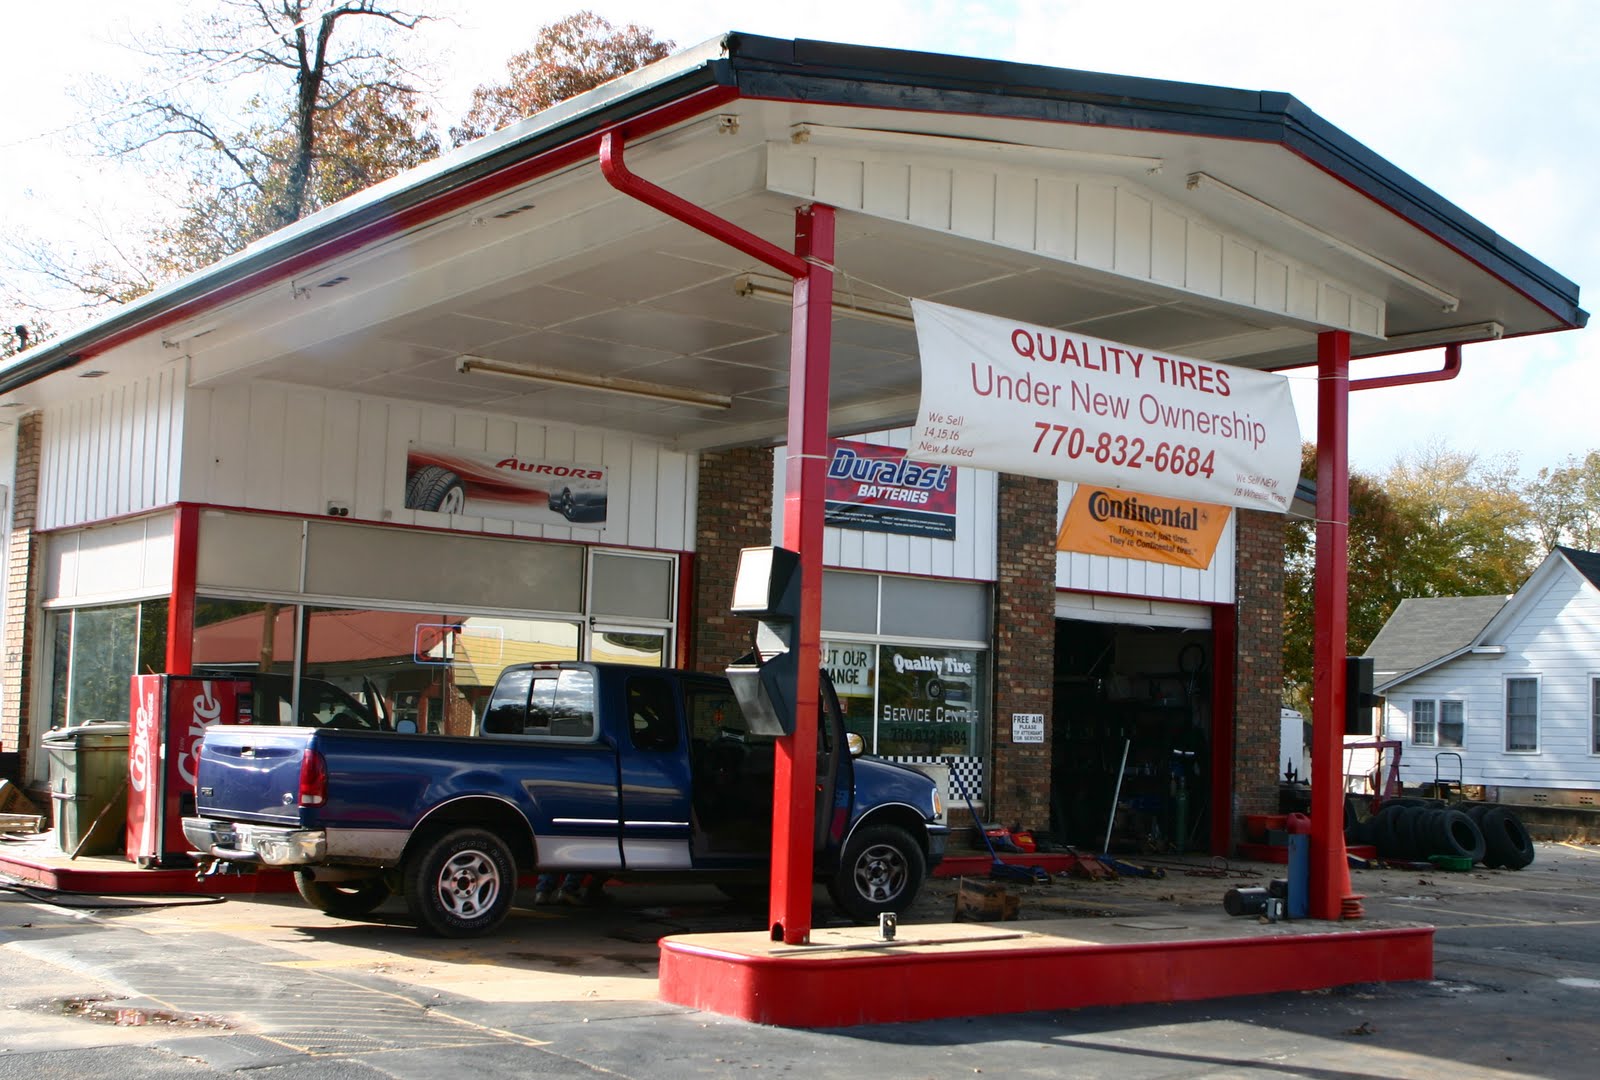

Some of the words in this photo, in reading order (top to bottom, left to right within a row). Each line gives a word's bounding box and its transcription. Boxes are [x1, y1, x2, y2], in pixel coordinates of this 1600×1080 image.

[1011, 329, 1144, 378] QUALITY
[1152, 356, 1231, 396] TIRES
[928, 412, 943, 423] We
[945, 415, 964, 426] Sell
[971, 362, 1061, 407] Under
[1071, 380, 1130, 419] New
[1139, 394, 1266, 450] Ownership
[918, 441, 939, 453] New
[941, 444, 949, 454] &
[951, 446, 975, 457] Used
[1033, 421, 1216, 479] 770-832-6684
[827, 447, 952, 492] Duralast
[1260, 477, 1280, 488] NEW
[857, 484, 929, 504] BATTERIES
[1088, 490, 1198, 531] Continental
[843, 650, 867, 667] OUR
[893, 653, 942, 676] Quality
[944, 657, 971, 673] Tire
[130, 706, 148, 792] Coke
